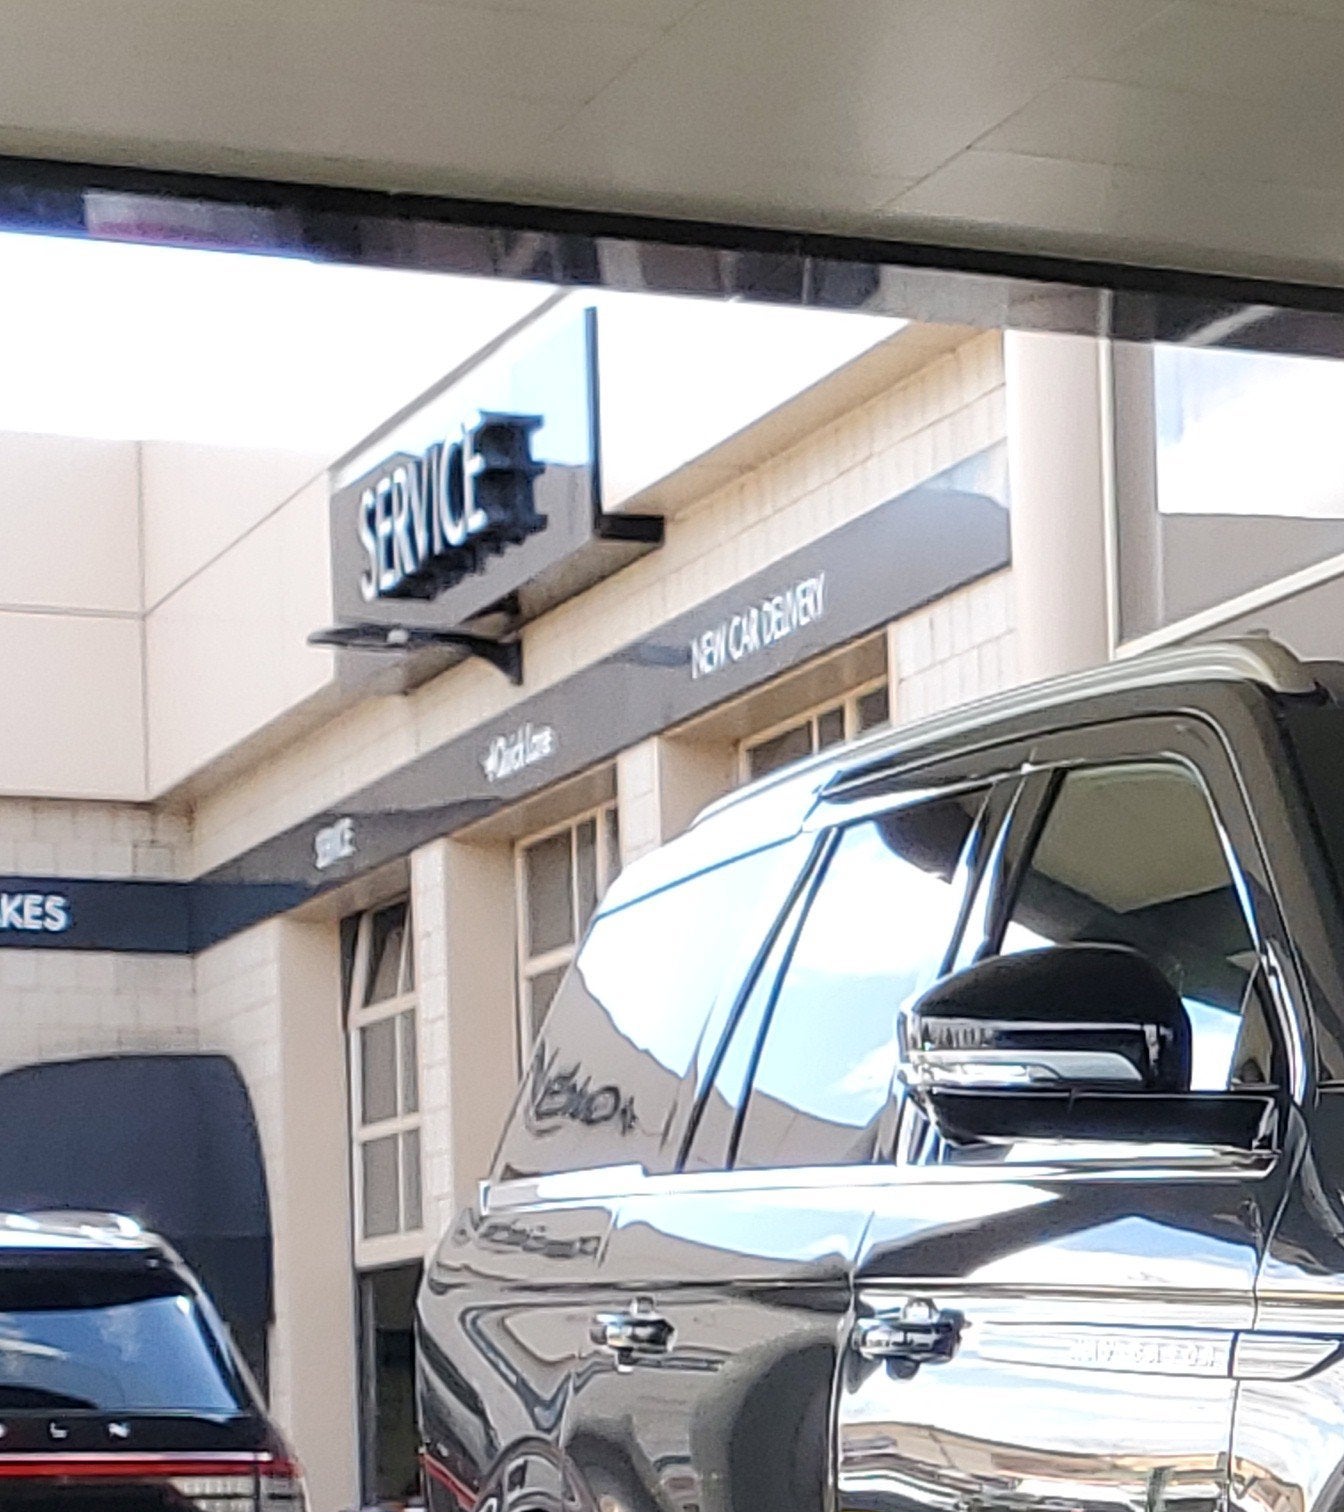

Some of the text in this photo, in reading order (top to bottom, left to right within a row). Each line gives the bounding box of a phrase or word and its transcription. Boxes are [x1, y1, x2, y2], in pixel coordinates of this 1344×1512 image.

[359, 409, 492, 602] SERVICE
[691, 622, 727, 679] NEW
[729, 606, 760, 660] CAR
[0, 893, 68, 932] KES
